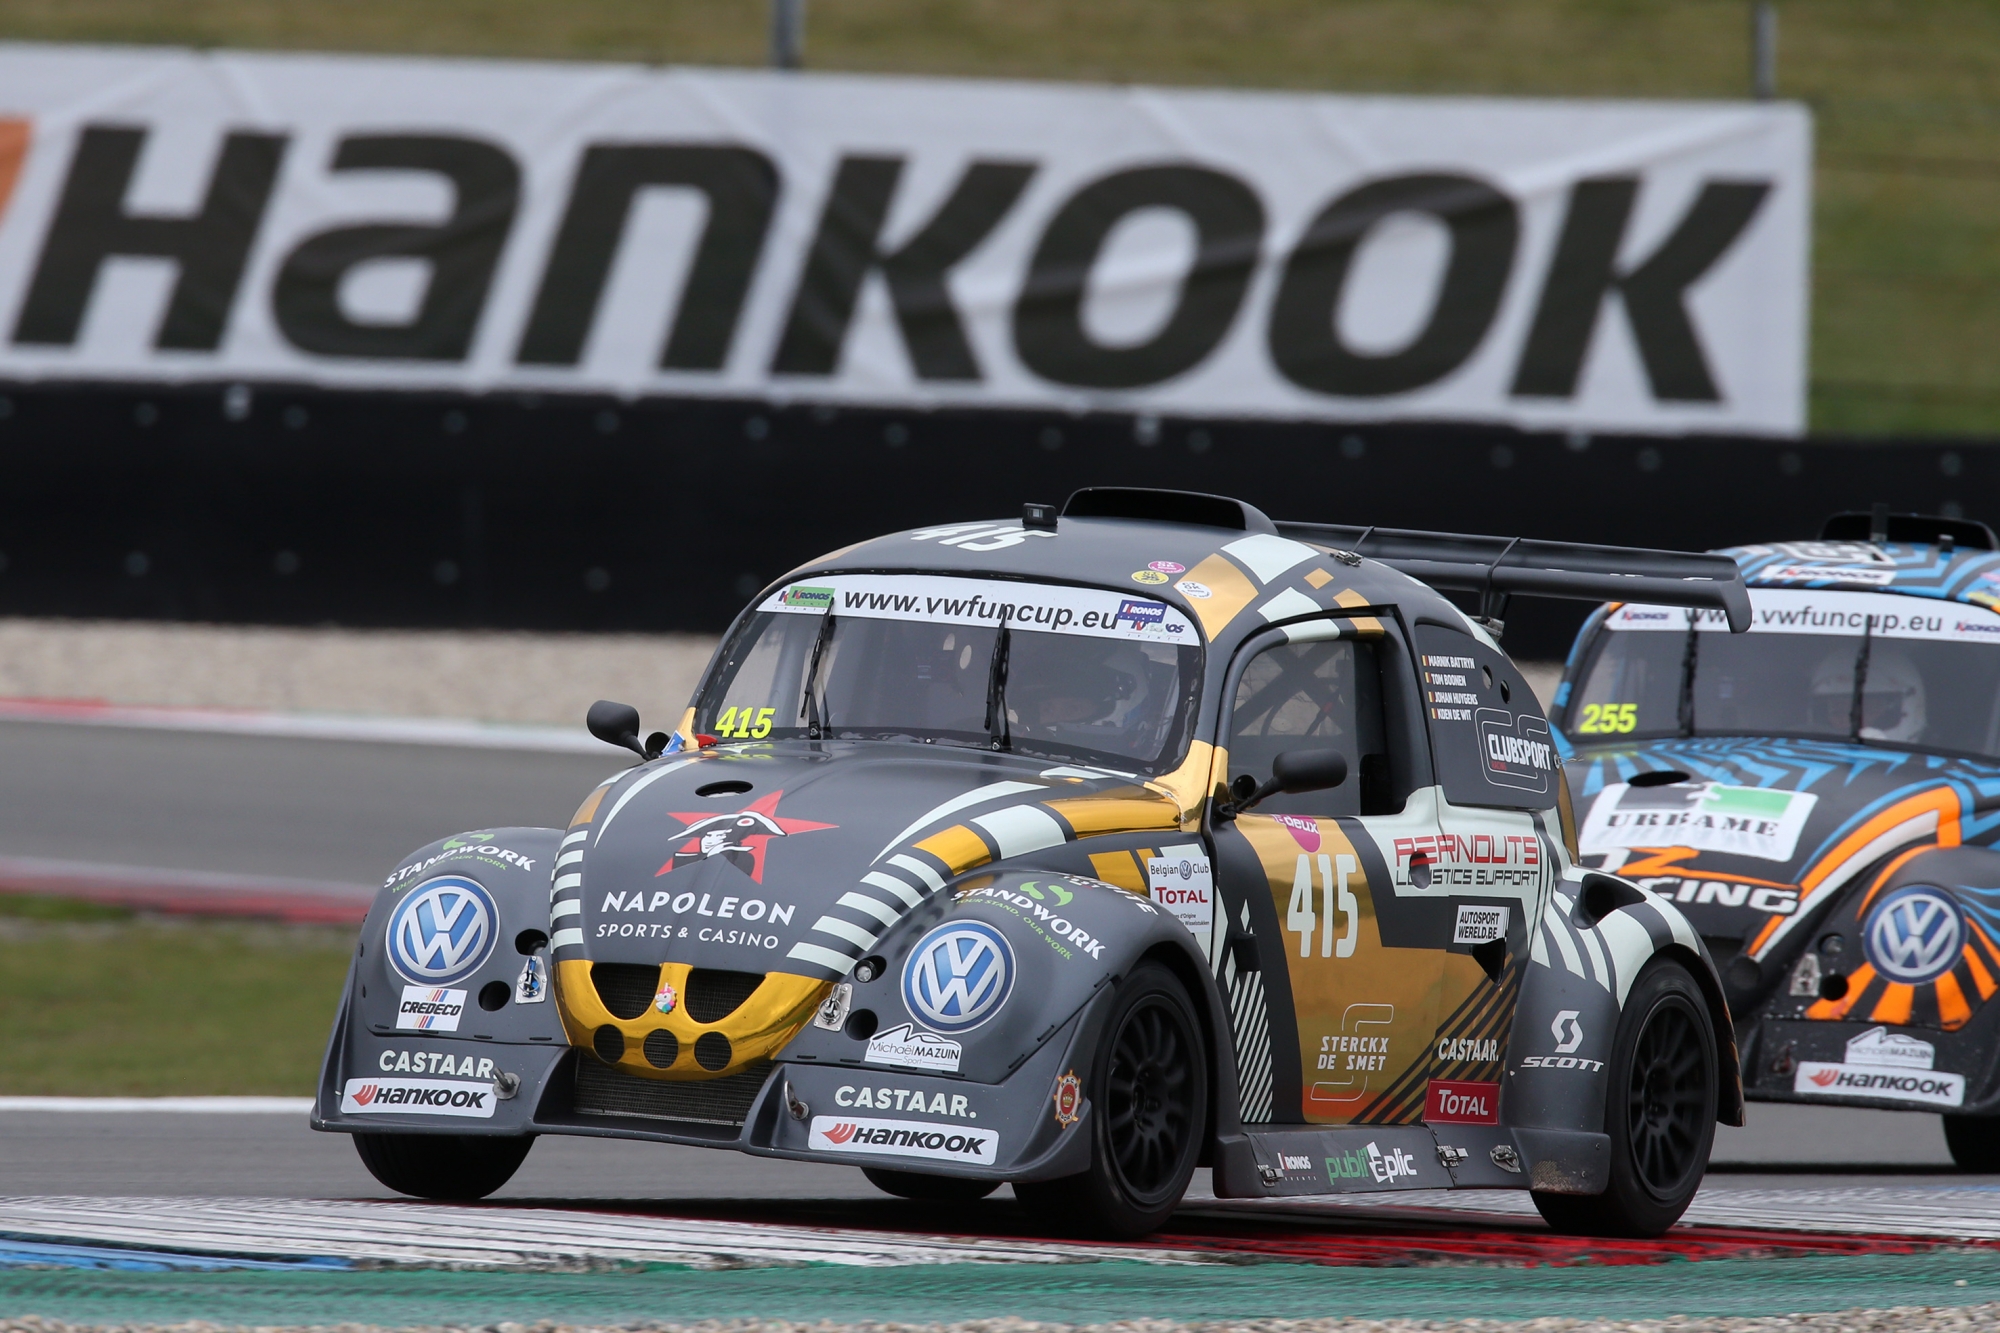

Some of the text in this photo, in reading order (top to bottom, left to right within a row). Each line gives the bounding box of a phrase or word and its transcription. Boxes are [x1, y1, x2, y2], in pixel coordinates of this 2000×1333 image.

[910, 524, 1058, 551] 415
[792, 588, 831, 600] KRONOS
[844, 591, 1119, 630] www.vwfuncup.eu
[1122, 602, 1163, 615] KRONOS
[1431, 673, 1444, 685] TOM
[714, 706, 776, 739] 415
[1452, 709, 1461, 720] DE
[1460, 709, 1472, 721] WIT
[1579, 703, 1637, 734] 255
[1488, 733, 1551, 771] CLUBSPORT
[384, 844, 536, 888] STANDWORK
[476, 855, 508, 871] WORK
[1150, 865, 1179, 878] Belgian
[1193, 863, 1210, 874] Club
[1476, 870, 1539, 887] SUPPORT
[601, 891, 796, 926] NAPOLEON
[1287, 854, 1357, 958] 415
[950, 887, 1107, 961] STANDWORK
[1459, 911, 1500, 925] AUTOSPORT
[596, 924, 779, 950] SPORTS & CASINO
[986, 899, 1020, 918] STAND,
[1022, 916, 1044, 936] OUR
[1044, 934, 1074, 961] WORK
[1458, 926, 1498, 940] WERELD.BE
[401, 1001, 461, 1016] CREDECO
[1321, 1036, 1389, 1052] STERCKX
[1438, 1038, 1499, 1062] CASTAAR.
[1317, 1054, 1386, 1071] DE SMET
[1520, 1056, 1604, 1073] SCOTT
[834, 1085, 977, 1119] CASTAAR.
